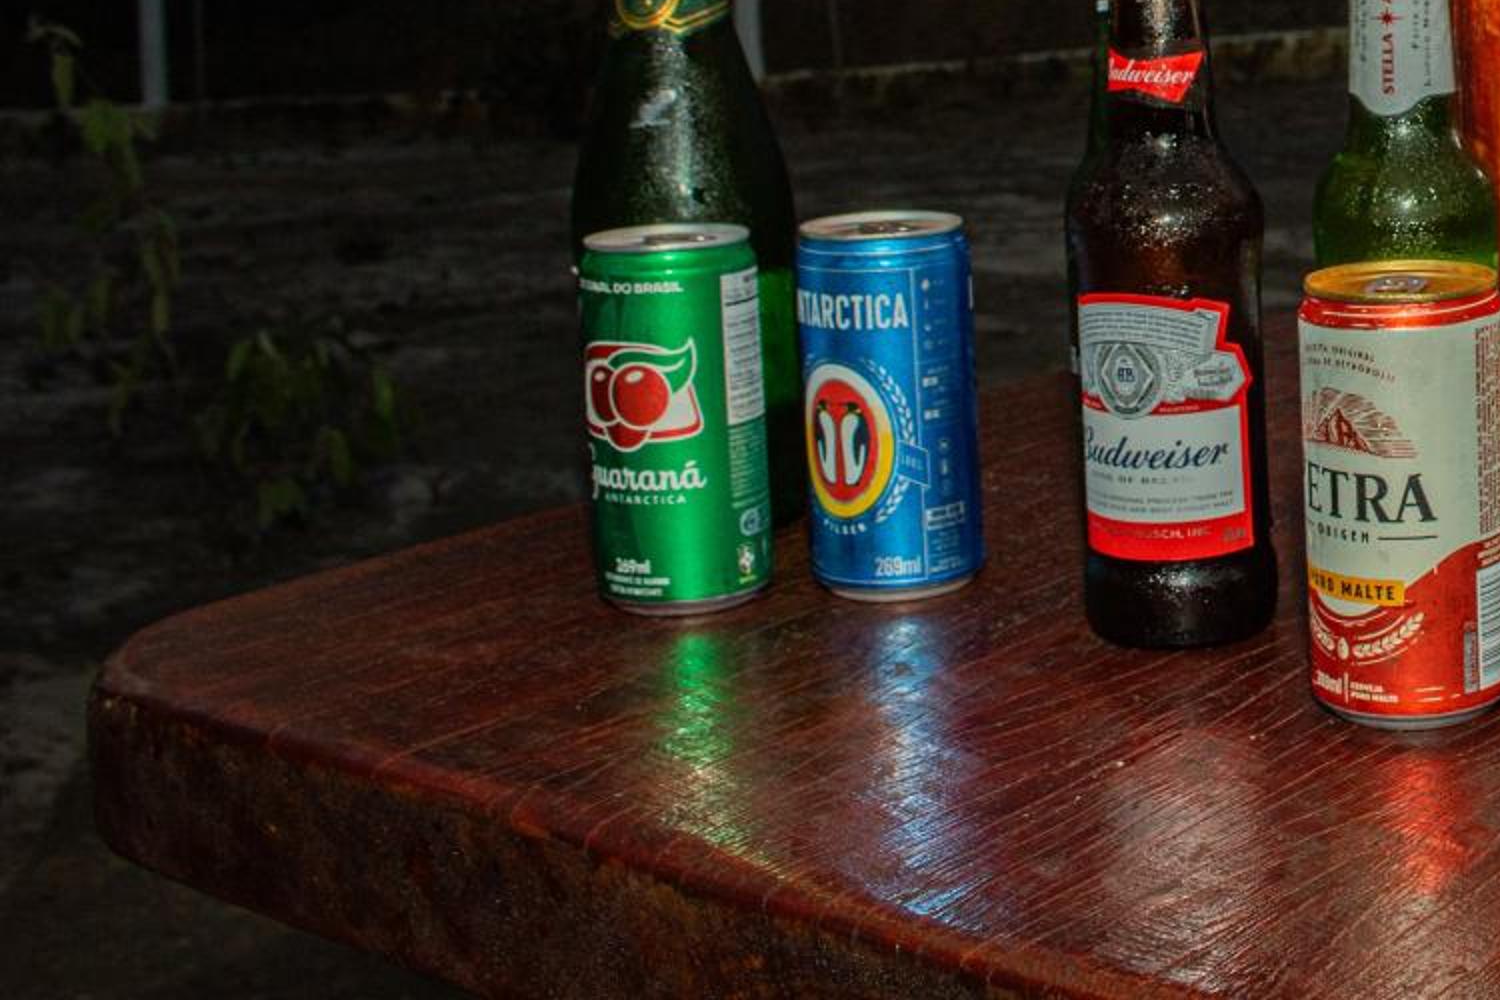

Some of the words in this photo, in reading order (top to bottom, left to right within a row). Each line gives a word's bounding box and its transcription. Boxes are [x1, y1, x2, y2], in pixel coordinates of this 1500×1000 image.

[1382, 33, 1396, 95] STELLA
[1308, 461, 1437, 523] ETRA
[1341, 580, 1396, 601] MALTE
